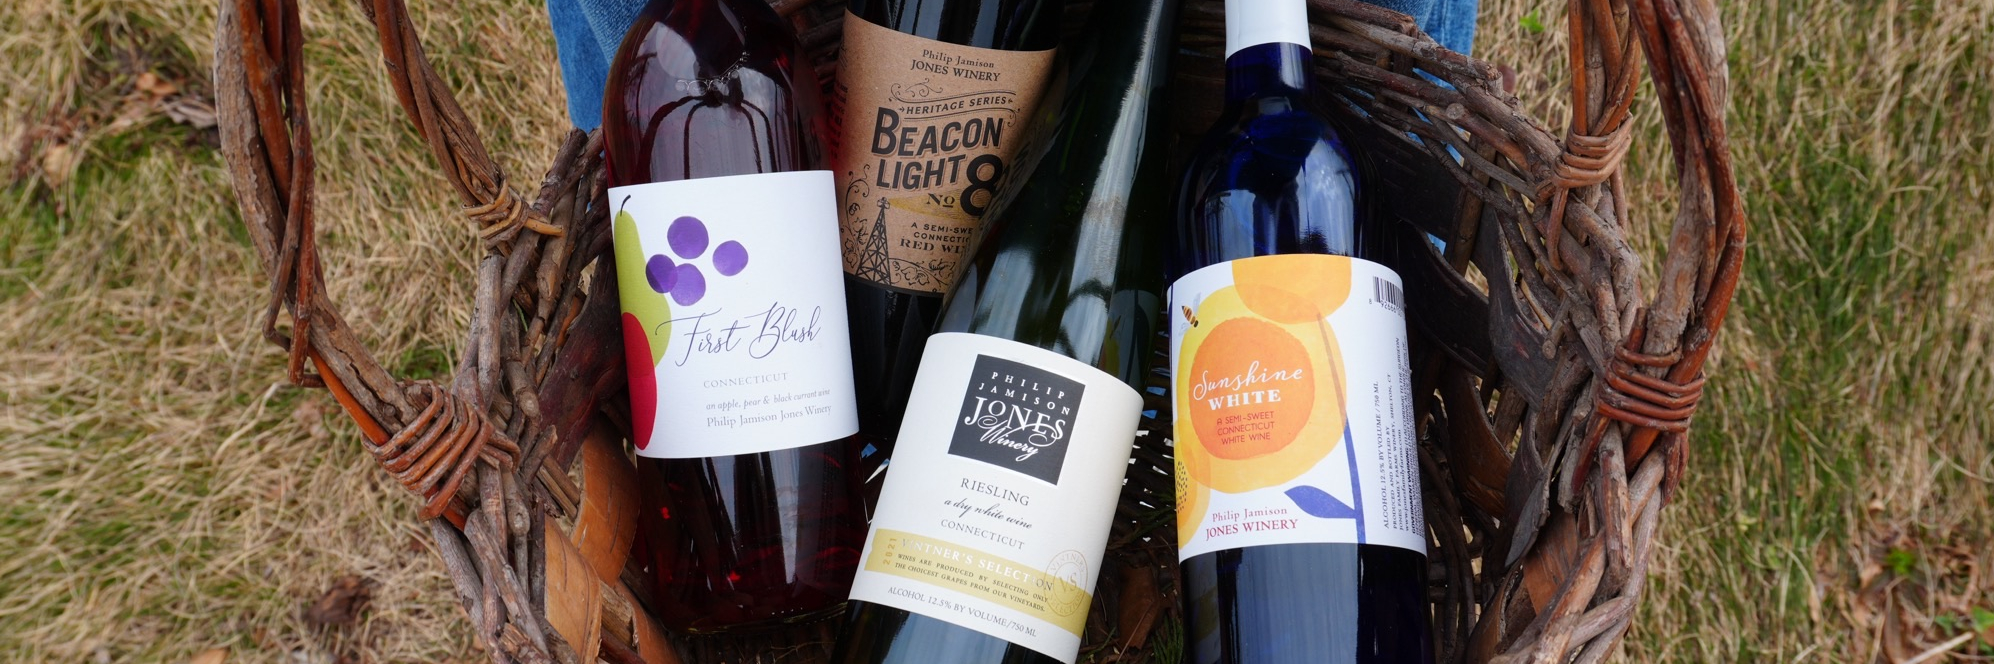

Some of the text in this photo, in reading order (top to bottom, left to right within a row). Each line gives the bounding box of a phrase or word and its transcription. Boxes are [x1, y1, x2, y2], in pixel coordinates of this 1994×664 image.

[911, 59, 1001, 82] JONES WINERY
[922, 49, 994, 68] Philip Jamison
[906, 96, 1007, 114] HERITAGE SERIES
[871, 106, 1004, 157] BEACON
[876, 154, 967, 190] LIGHT
[960, 154, 1003, 217] 8
[913, 231, 970, 243] CONNECTI
[923, 223, 974, 235] SEMI-SWE
[900, 238, 965, 254] RED WI
[655, 301, 822, 367] First Blush
[703, 372, 788, 389] CONNECTICUT
[991, 371, 1065, 399] PHILIP
[1193, 360, 1303, 401] Sunshine
[1373, 381, 1379, 393] ML
[718, 399, 741, 412] apple,
[743, 399, 760, 409] pear
[763, 395, 770, 404] &
[773, 393, 793, 403] black
[793, 390, 817, 401] currant
[978, 382, 1071, 416] JAMISON
[1208, 389, 1281, 410] WHITE
[706, 405, 832, 428] Philip Jamison Jones Winery
[964, 396, 1066, 440] JONES
[1217, 421, 1275, 436] CONNECTICUT
[977, 415, 1058, 462] Winery
[1221, 432, 1270, 445] WHITE WINE
[1376, 414, 1384, 449] VOLUME
[1385, 427, 1390, 437] BY
[1378, 450, 1385, 461] BY
[960, 478, 1030, 506] RIESLING
[953, 498, 972, 518] dry
[974, 503, 1005, 520] white
[1006, 517, 1033, 530] wine
[1212, 506, 1288, 523] Philip Jamison
[1380, 486, 1389, 530] ALCOHOL
[1389, 490, 1397, 530] PRODUCED
[1408, 484, 1416, 534] GOVERNMENT
[940, 519, 1025, 550] CONNECTICUT
[1206, 519, 1298, 541] JONES WINERY
[882, 538, 897, 565] 2021
[898, 553, 916, 562] WINES
[936, 562, 974, 577] PRODUCED
[992, 579, 1029, 596] SELECTING
[1032, 593, 1048, 603] ONLY
[907, 565, 939, 577] CHOICEST
[941, 574, 968, 585] GRAPES
[970, 583, 990, 593] FROM
[992, 589, 1007, 598] OUR
[1010, 594, 1045, 612] VINEYARDS.
[978, 558, 1054, 591] SELECTION
[888, 586, 925, 602] ALCOHOL
[928, 596, 952, 609] 12.5%
[953, 603, 966, 613] BY
[1025, 627, 1037, 637] ML
